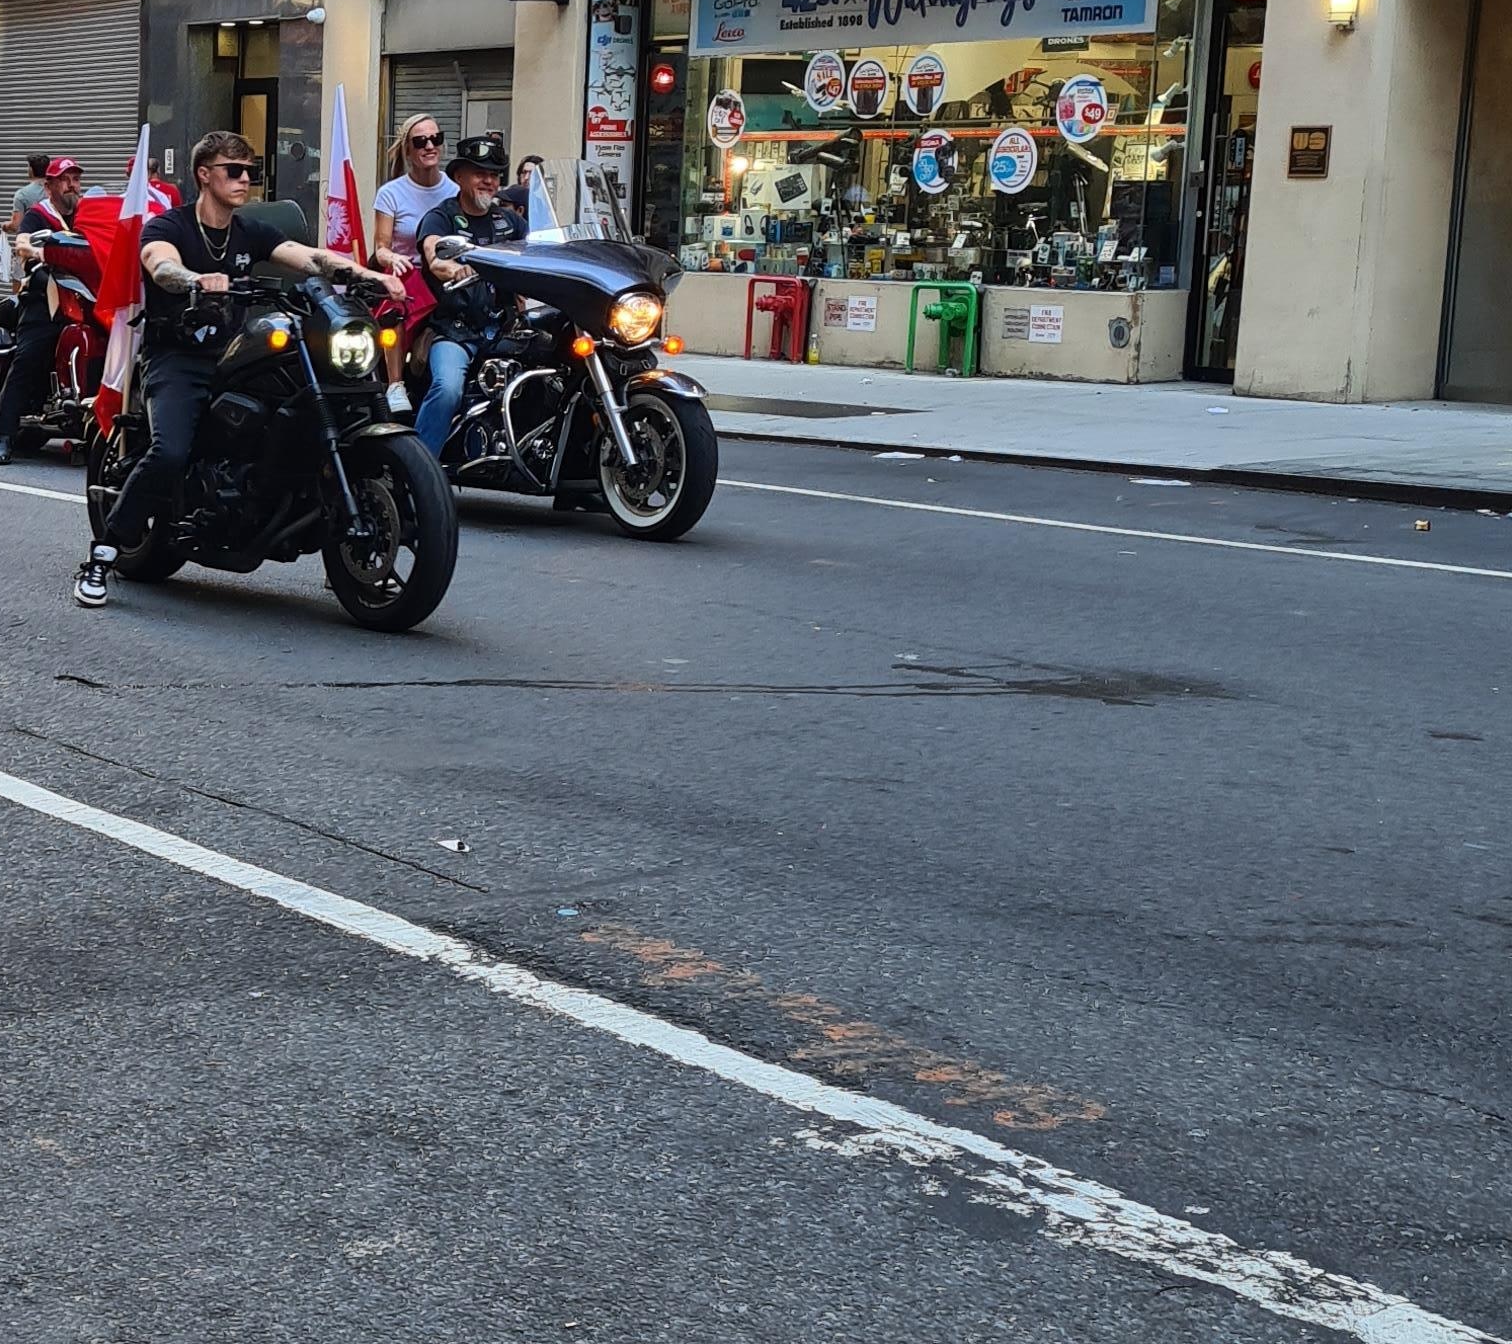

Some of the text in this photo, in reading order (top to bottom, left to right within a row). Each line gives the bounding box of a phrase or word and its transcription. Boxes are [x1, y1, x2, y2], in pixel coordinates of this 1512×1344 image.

[780, 14, 863, 31] Established 1898
[1061, 5, 1123, 23] TAMRON
[712, 21, 745, 42] Leica
[1085, 107, 1102, 120] $49
